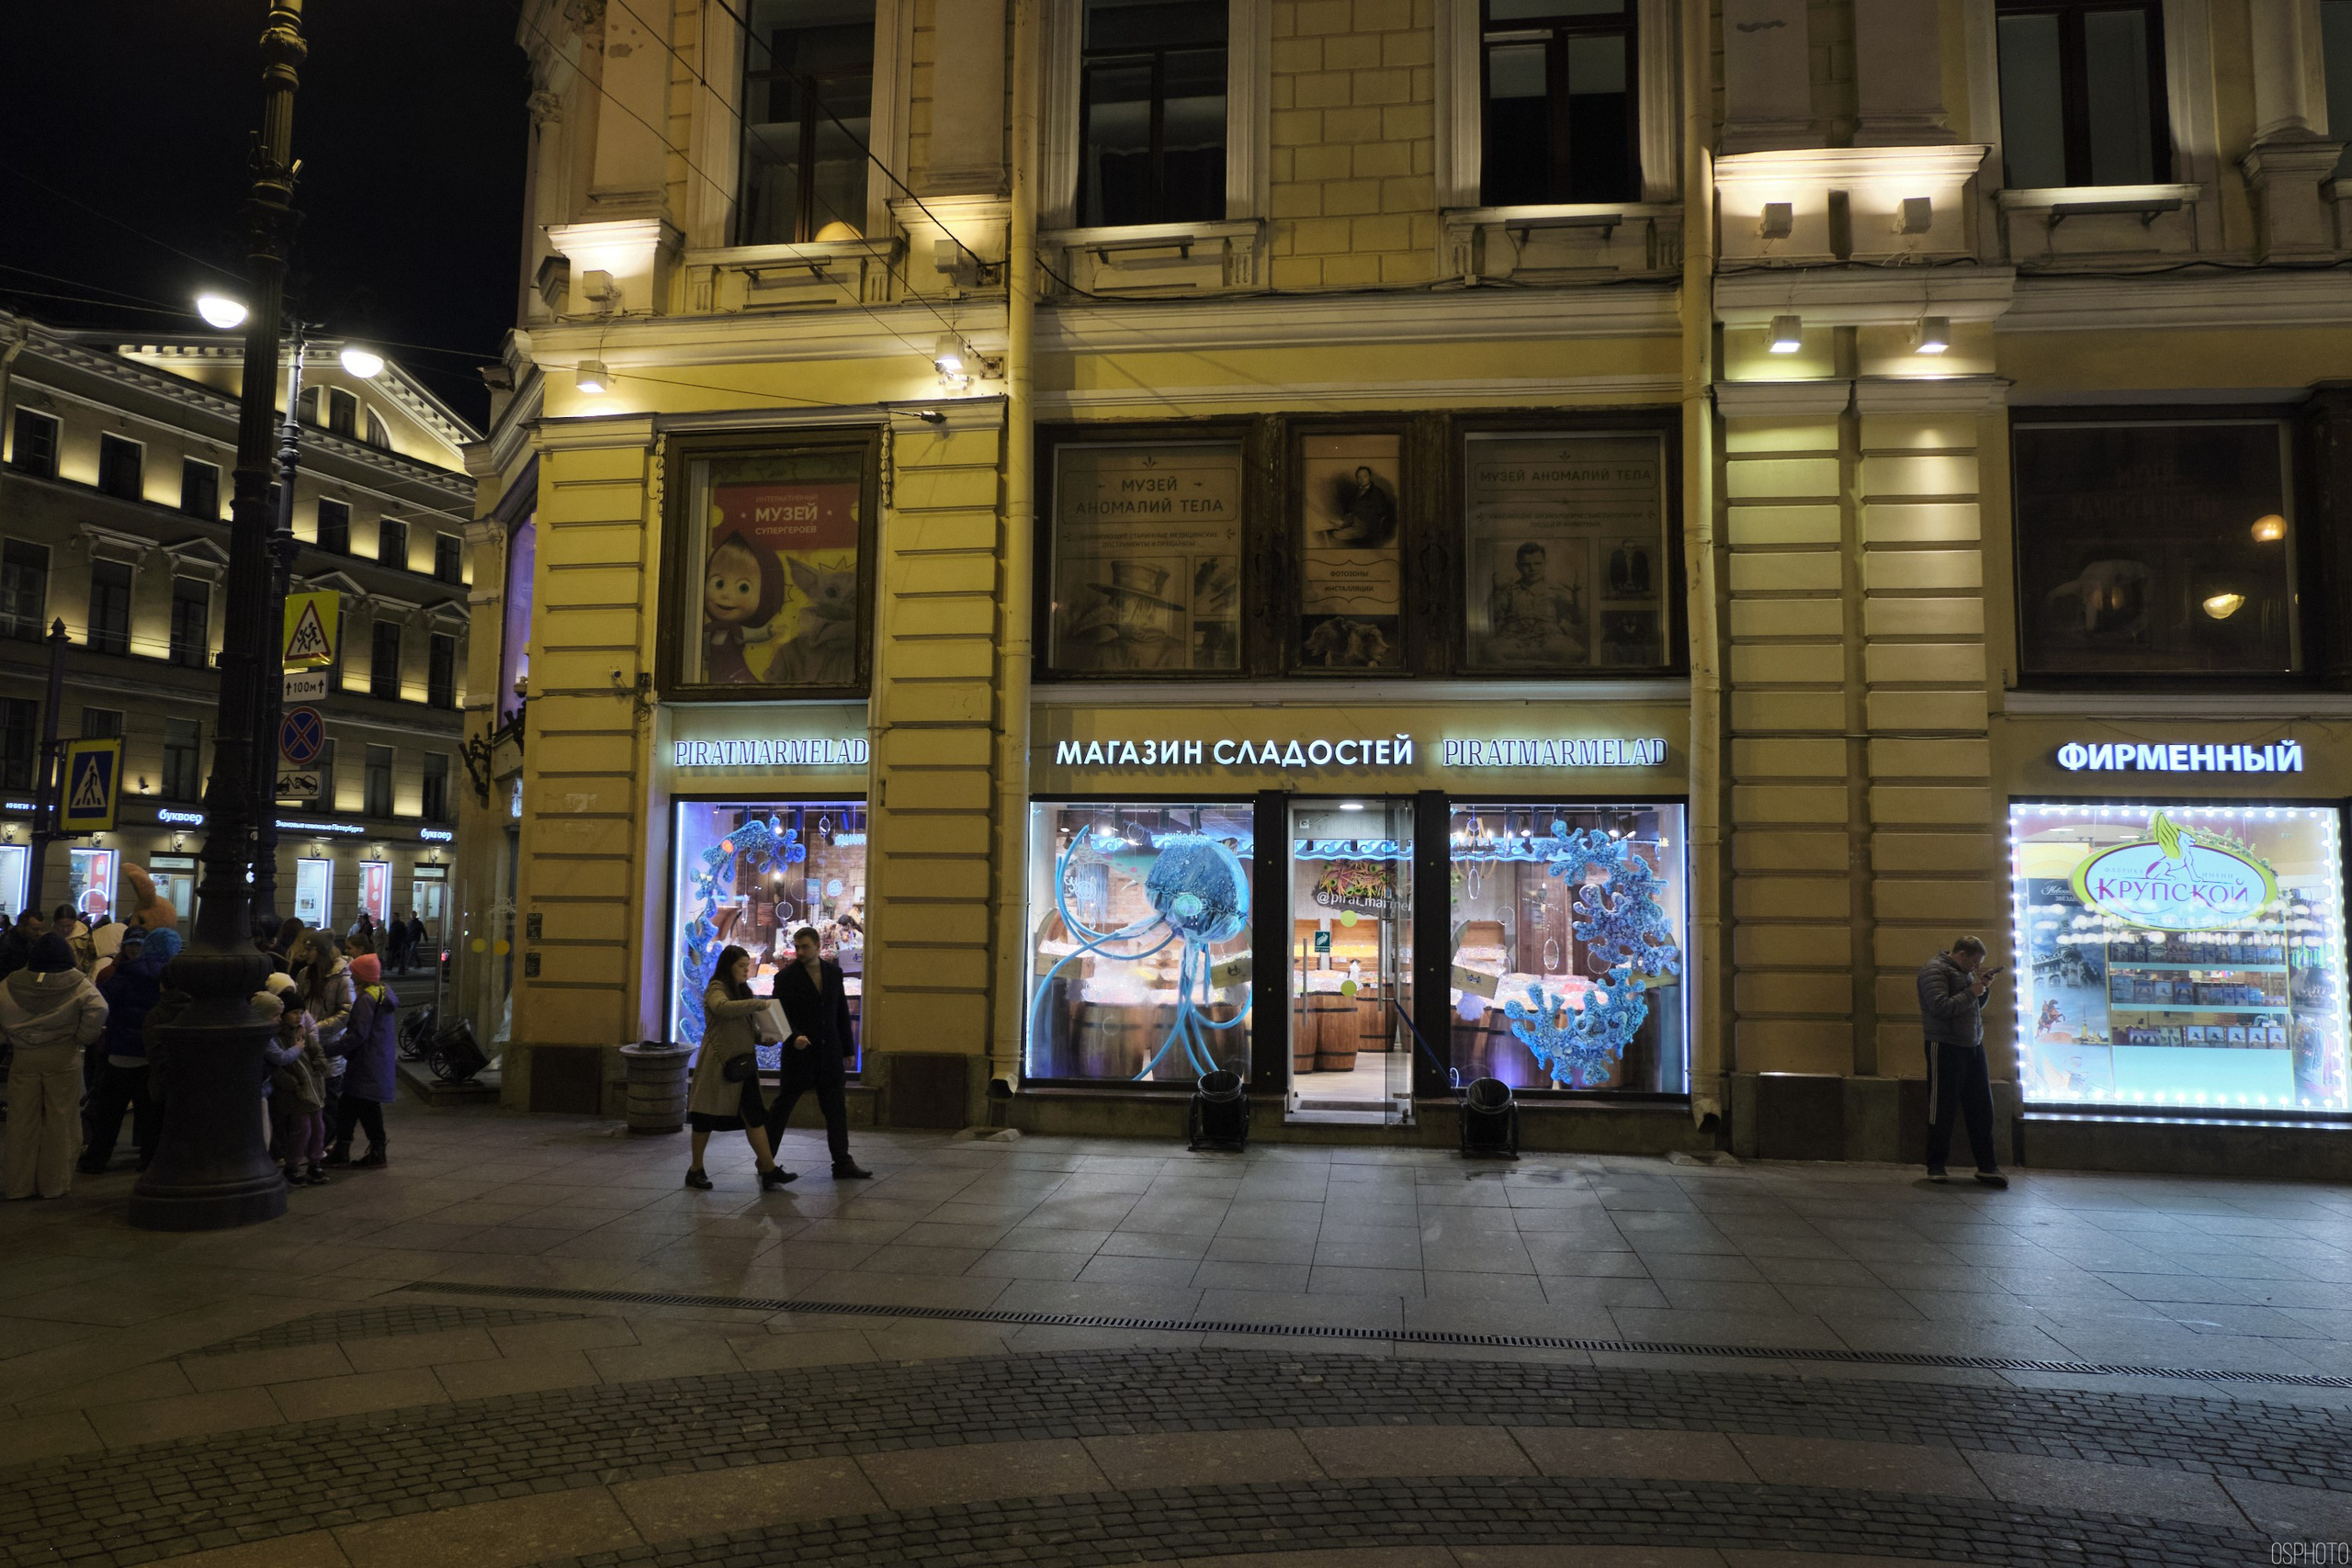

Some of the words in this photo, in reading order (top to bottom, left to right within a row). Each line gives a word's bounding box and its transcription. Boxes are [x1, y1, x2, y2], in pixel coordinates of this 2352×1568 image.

[1480, 468, 1525, 482] МУЗЕЙ
[1532, 468, 1610, 481] АНОМАЛИЙ
[1617, 469, 1652, 481] ТЕЛА
[1121, 476, 1178, 492] МУЗЕЙ
[755, 493, 819, 503] ИНТЕРАКТИВНЫЙ
[1075, 497, 1172, 514] АНОМАЛИЙ
[1180, 499, 1224, 513] ТЕЛА
[755, 502, 818, 523] МУЗЕЙ
[754, 525, 818, 536] СУПЕРГЕРОЕВ
[1329, 570, 1369, 578] ФОТОЗОНЫ
[1324, 584, 1374, 593] ИНСТАЛЛЯЦИИ
[674, 739, 869, 766] PIRATMARMELAD
[1056, 739, 1202, 765] МАГАЗИН
[1213, 733, 1413, 768] СЛАДОСТЕЙ
[1442, 738, 1668, 766] PIRATMARMELAD
[2057, 739, 2303, 772] ФИРМЕННЫЙ
[2104, 866, 2144, 874] ФАБРИКА
[2096, 876, 2249, 905] КРУПСКОЙ
